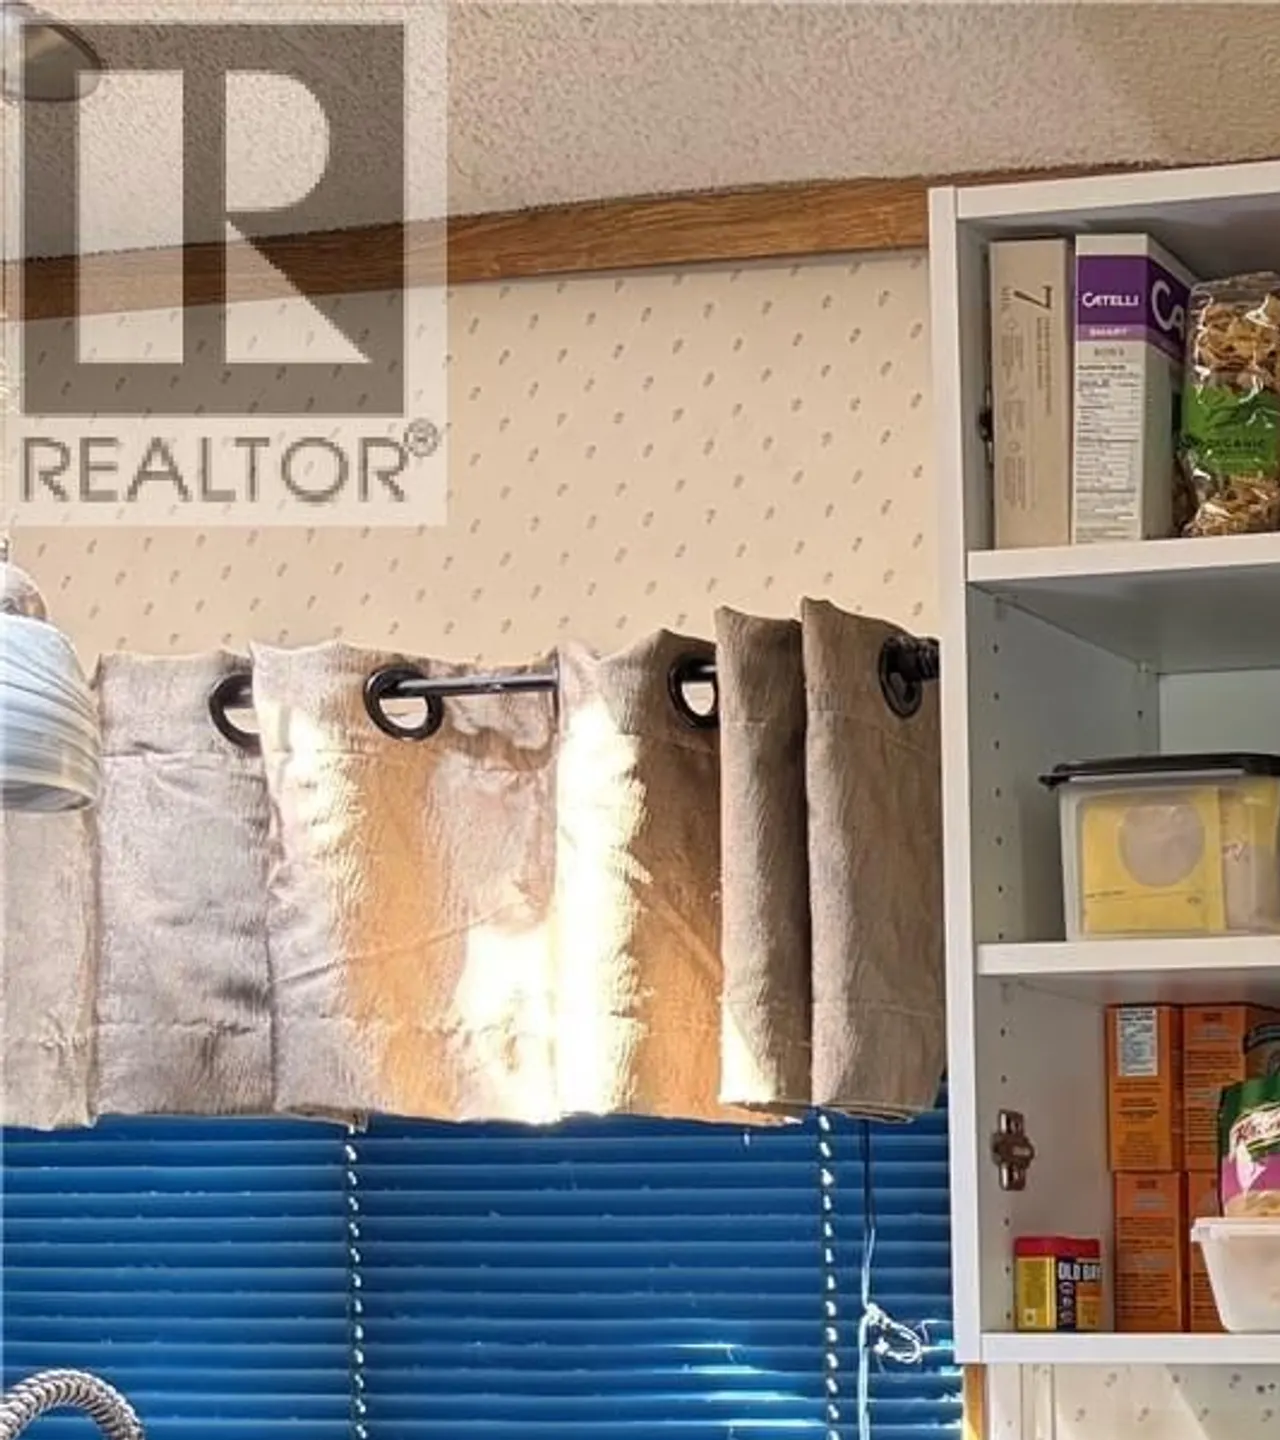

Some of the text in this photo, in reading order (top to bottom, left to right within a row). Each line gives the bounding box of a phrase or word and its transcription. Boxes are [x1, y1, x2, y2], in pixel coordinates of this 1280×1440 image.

[1013, 285, 1052, 310] 7
[1082, 291, 1139, 308] CATELLI
[1058, 1261, 1081, 1281] OLD
